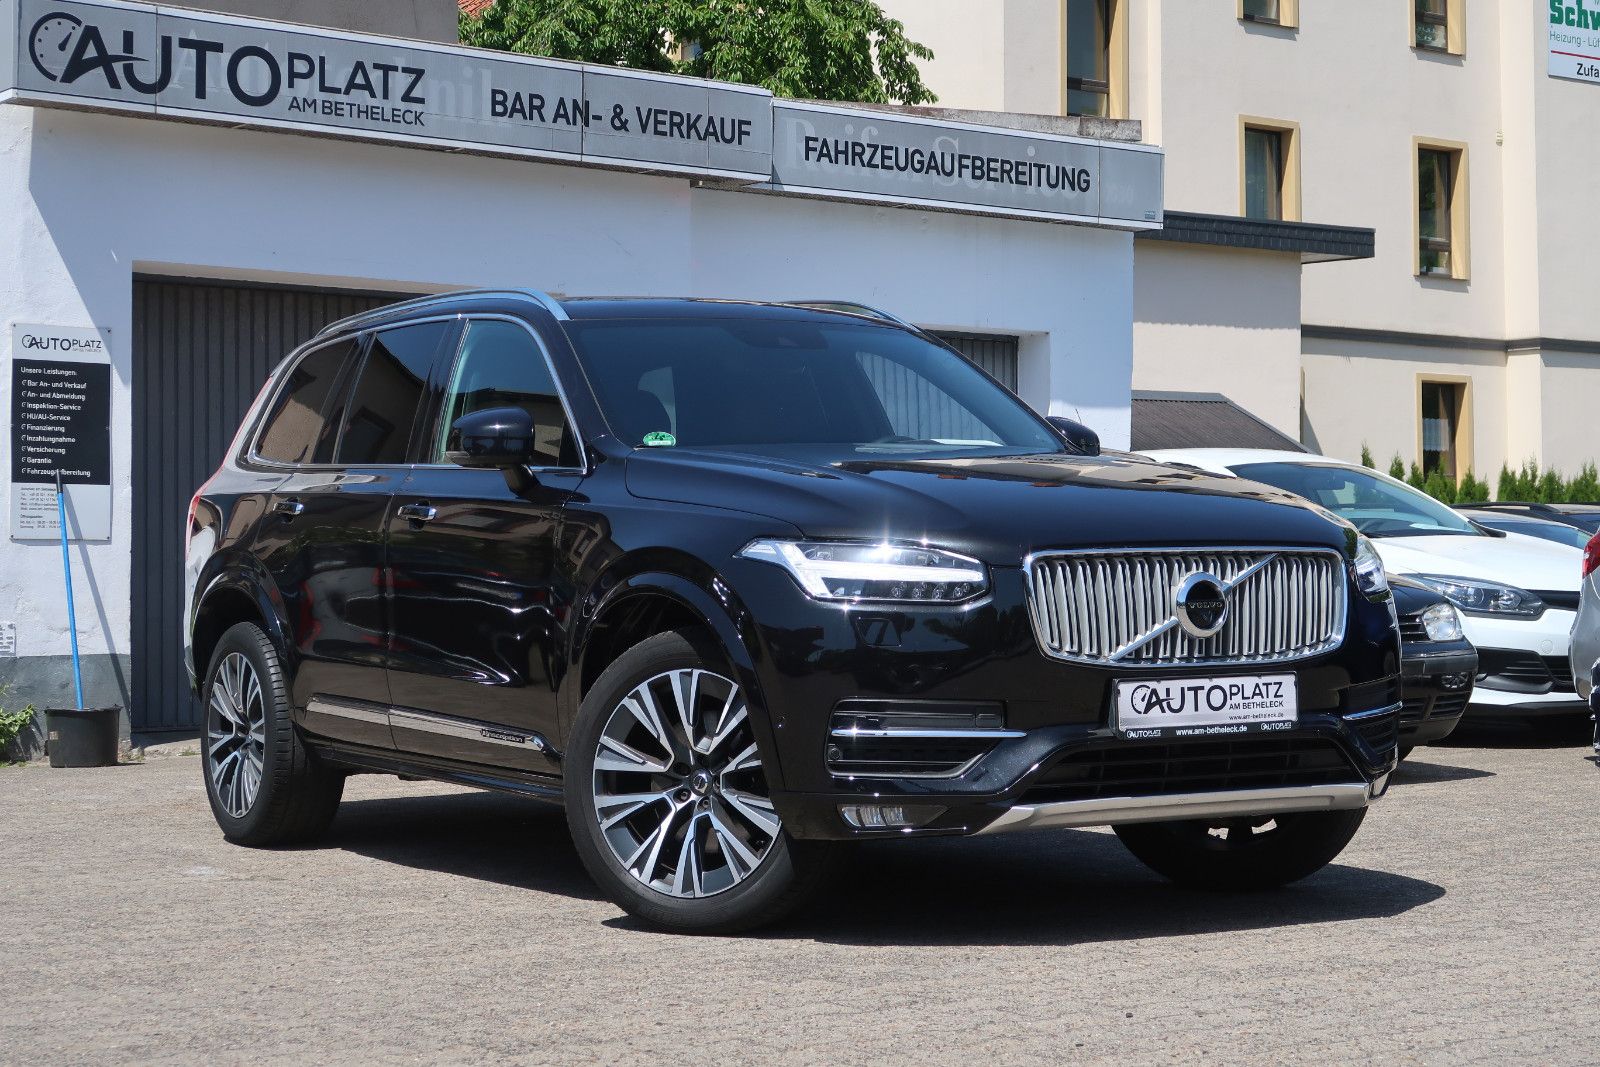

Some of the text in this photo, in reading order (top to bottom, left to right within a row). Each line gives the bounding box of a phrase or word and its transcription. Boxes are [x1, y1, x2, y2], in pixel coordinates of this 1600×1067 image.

[1550, 31, 1581, 47] Heizung
[1576, 63, 1600, 78] Zufa
[288, 96, 425, 126] AM BETHELECK
[491, 88, 752, 146] BAR AN- & VERKAUF
[804, 136, 1091, 193] FAHRZEUGAUFBEREITUNG
[20, 366, 42, 374] Unsere
[27, 379, 38, 387] Bar
[64, 381, 87, 389] Verkauf
[52, 392, 86, 402] Abmeldung
[26, 413, 71, 421] HU/AU-Service
[26, 424, 66, 433] Finanzierung
[26, 435, 76, 444] Inzahlungnahme
[26, 446, 66, 455] Versicherung
[26, 468, 91, 478] Fahrzeugfbereitung
[1242, 700, 1284, 710] BETHELECK
[1175, 725, 1248, 736] www.am-betheleck.de
